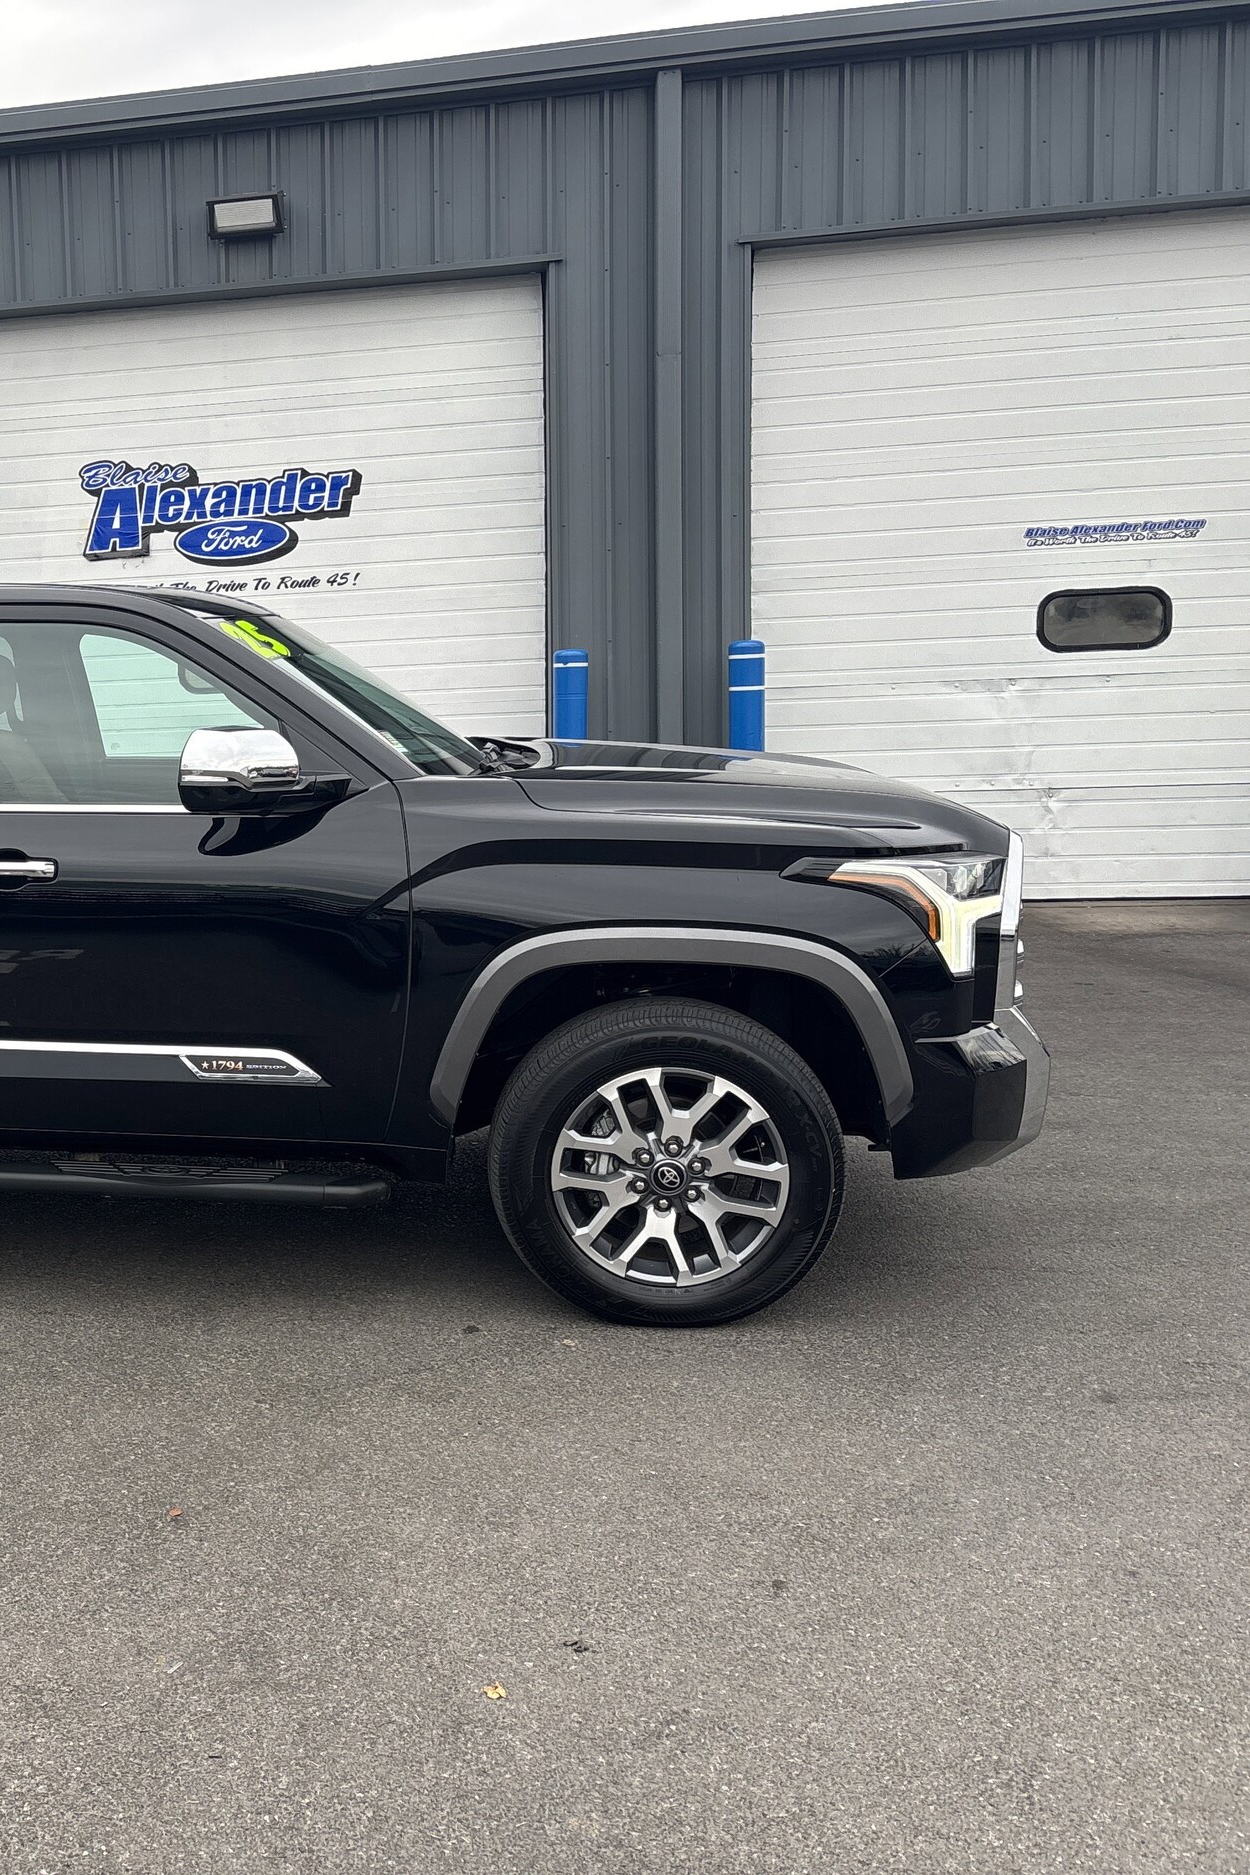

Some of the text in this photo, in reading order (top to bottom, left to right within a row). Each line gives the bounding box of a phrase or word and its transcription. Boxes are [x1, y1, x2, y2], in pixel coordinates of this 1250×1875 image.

[80, 462, 190, 490] Blaise
[85, 469, 353, 555] Alexander
[201, 525, 264, 552] Ford
[1024, 526, 1070, 538] Blaise
[1070, 522, 1141, 536] Alexander
[205, 580, 248, 592] Drive
[253, 577, 271, 591] To
[276, 576, 321, 590] Route
[211, 1060, 244, 1071] 1794
